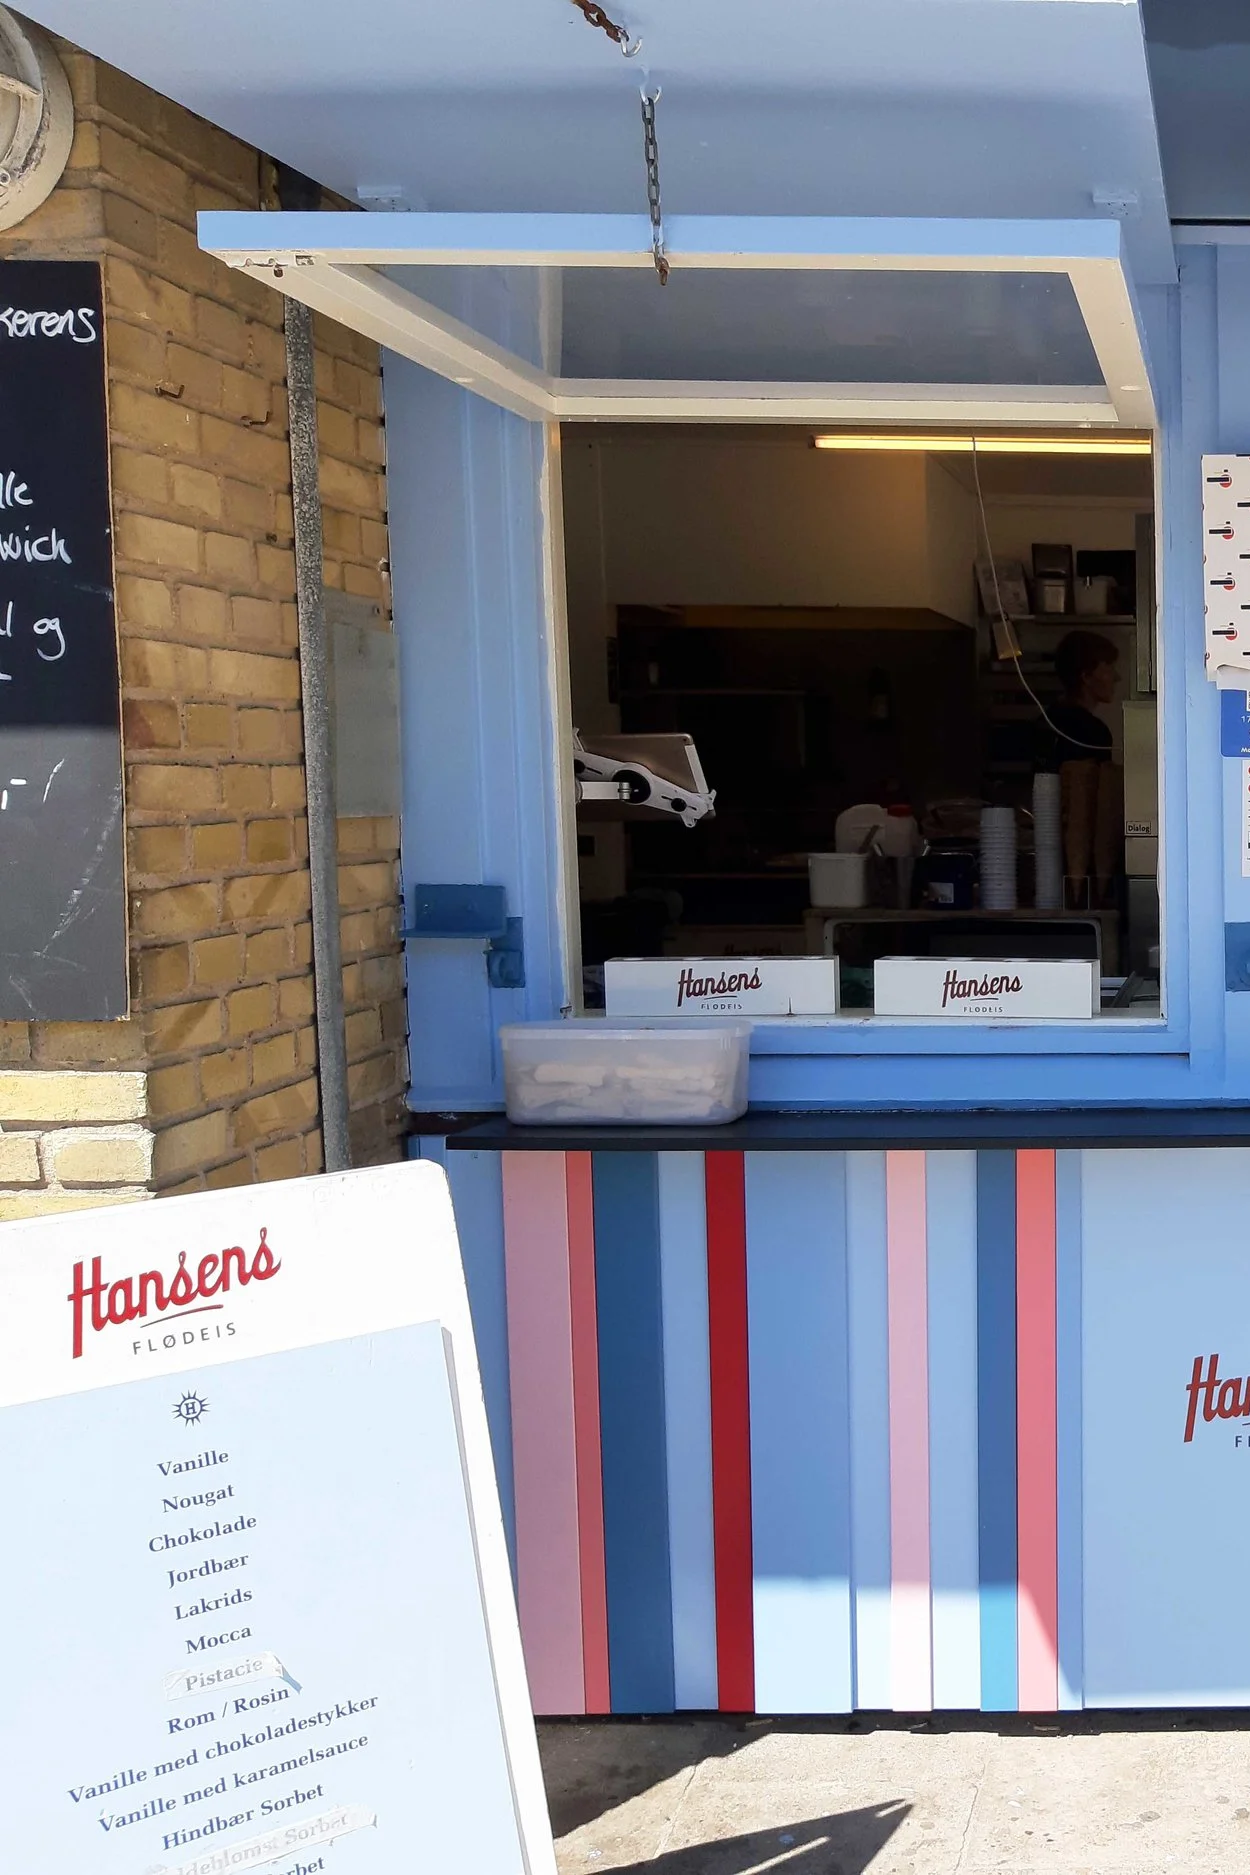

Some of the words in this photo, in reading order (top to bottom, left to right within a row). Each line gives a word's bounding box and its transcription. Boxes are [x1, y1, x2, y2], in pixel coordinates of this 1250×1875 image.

[1128, 824, 1150, 833] Dialog
[677, 967, 762, 1007] Hansens
[942, 969, 1024, 1008] Hansens
[67, 1226, 283, 1360] Hansens
[132, 1321, 237, 1356] FLØDEIS
[157, 1449, 230, 1478] Vanille
[161, 1483, 235, 1514] Nougat
[148, 1514, 258, 1553] Chokolade
[167, 1552, 250, 1589] Jordbær
[174, 1587, 254, 1621] Lakrids
[185, 1626, 253, 1654] Mocca
[184, 1657, 264, 1692] Pistacie
[167, 1709, 216, 1736] Rom
[233, 1686, 291, 1715] Rosin
[68, 1765, 148, 1805] Vanille
[154, 1747, 200, 1778] med
[205, 1693, 380, 1760] chokoladestykker
[98, 1796, 178, 1834] Vanille
[183, 1777, 228, 1806] med
[233, 1734, 370, 1788] karamelsauce
[162, 1808, 255, 1852] Hindbær
[260, 1782, 325, 1817] Sorbet
